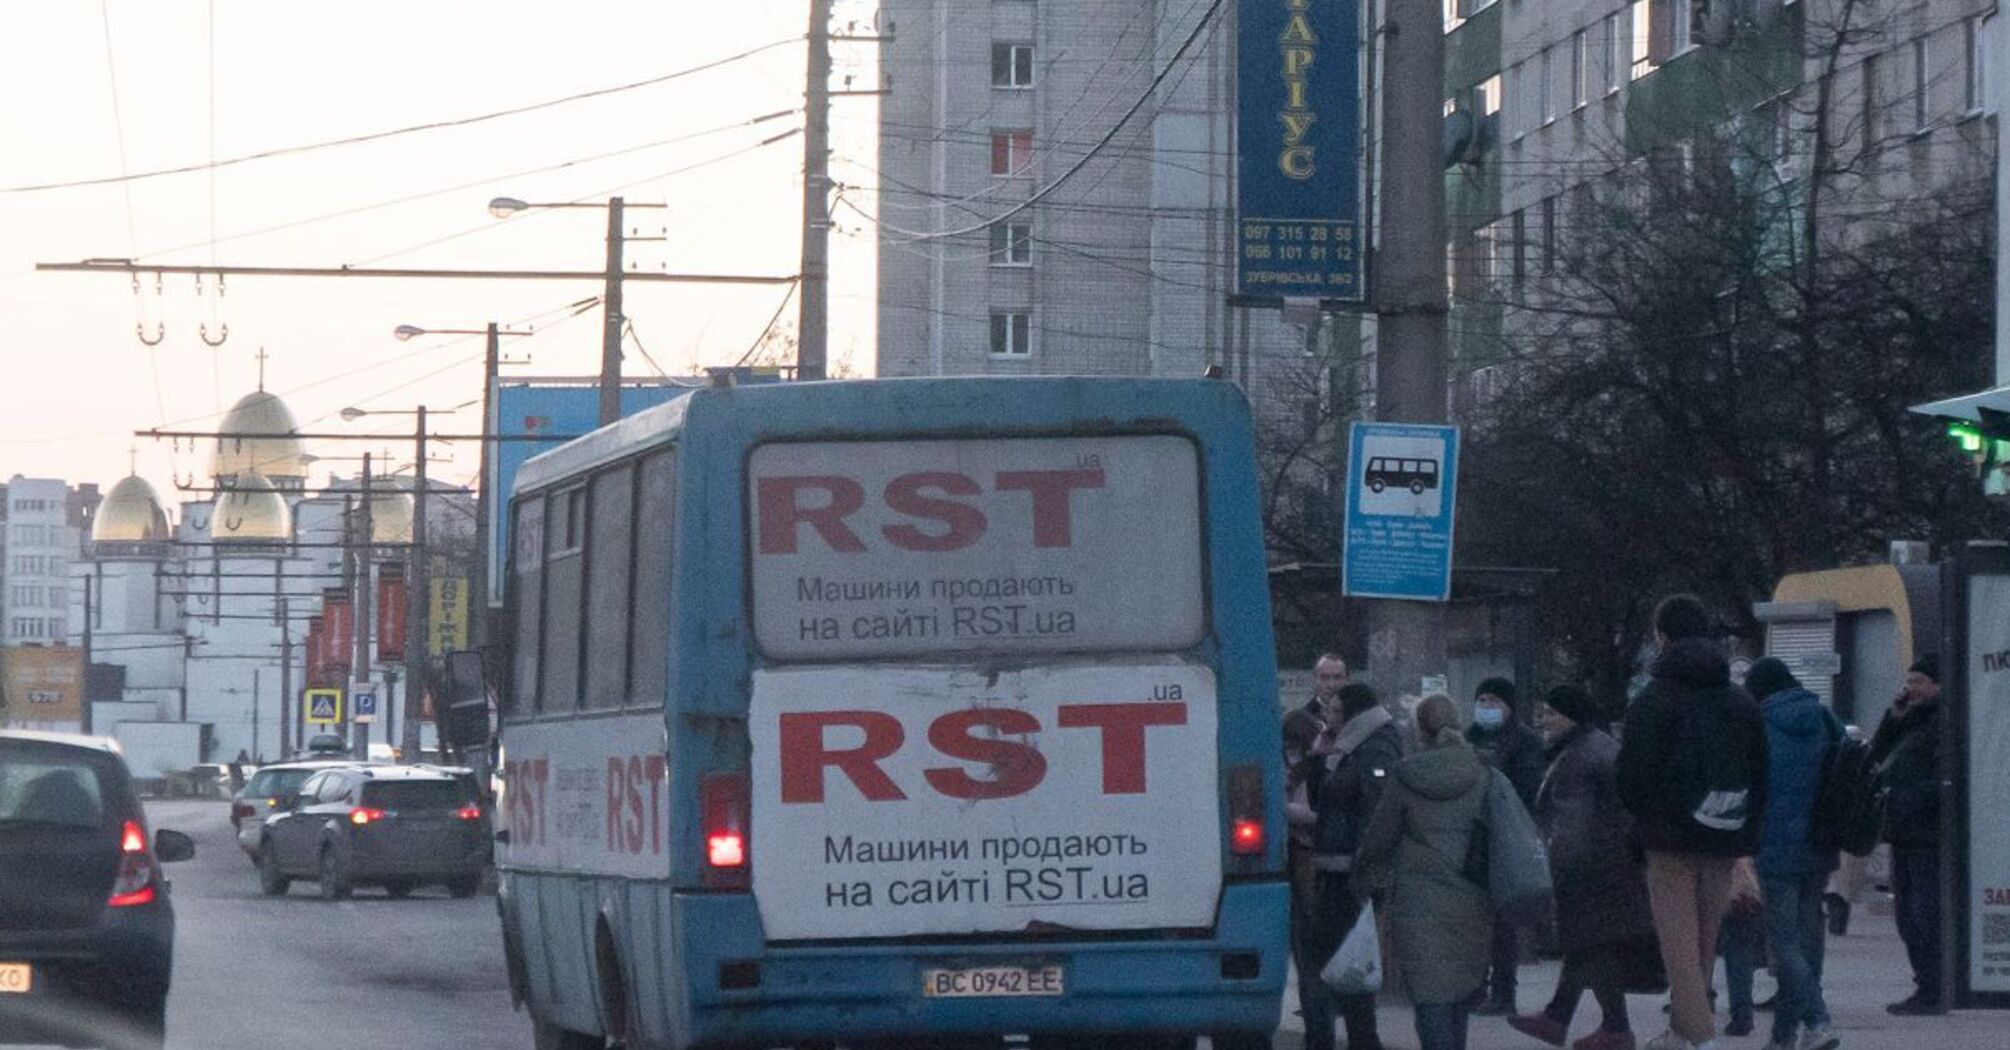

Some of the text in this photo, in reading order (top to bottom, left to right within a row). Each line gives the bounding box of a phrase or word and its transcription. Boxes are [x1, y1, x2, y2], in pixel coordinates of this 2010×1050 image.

[757, 468, 1105, 555] RST
[798, 574, 1073, 603] Машини продають
[800, 604, 1076, 640] на сайті RST.ua
[1147, 684, 1183, 701] .ua
[779, 702, 1188, 804] RST
[607, 754, 666, 856] RST
[825, 834, 1147, 865] Машини продають
[826, 867, 1149, 907] на сайті RST.ua
[936, 969, 1059, 994] BC 0942 EE
